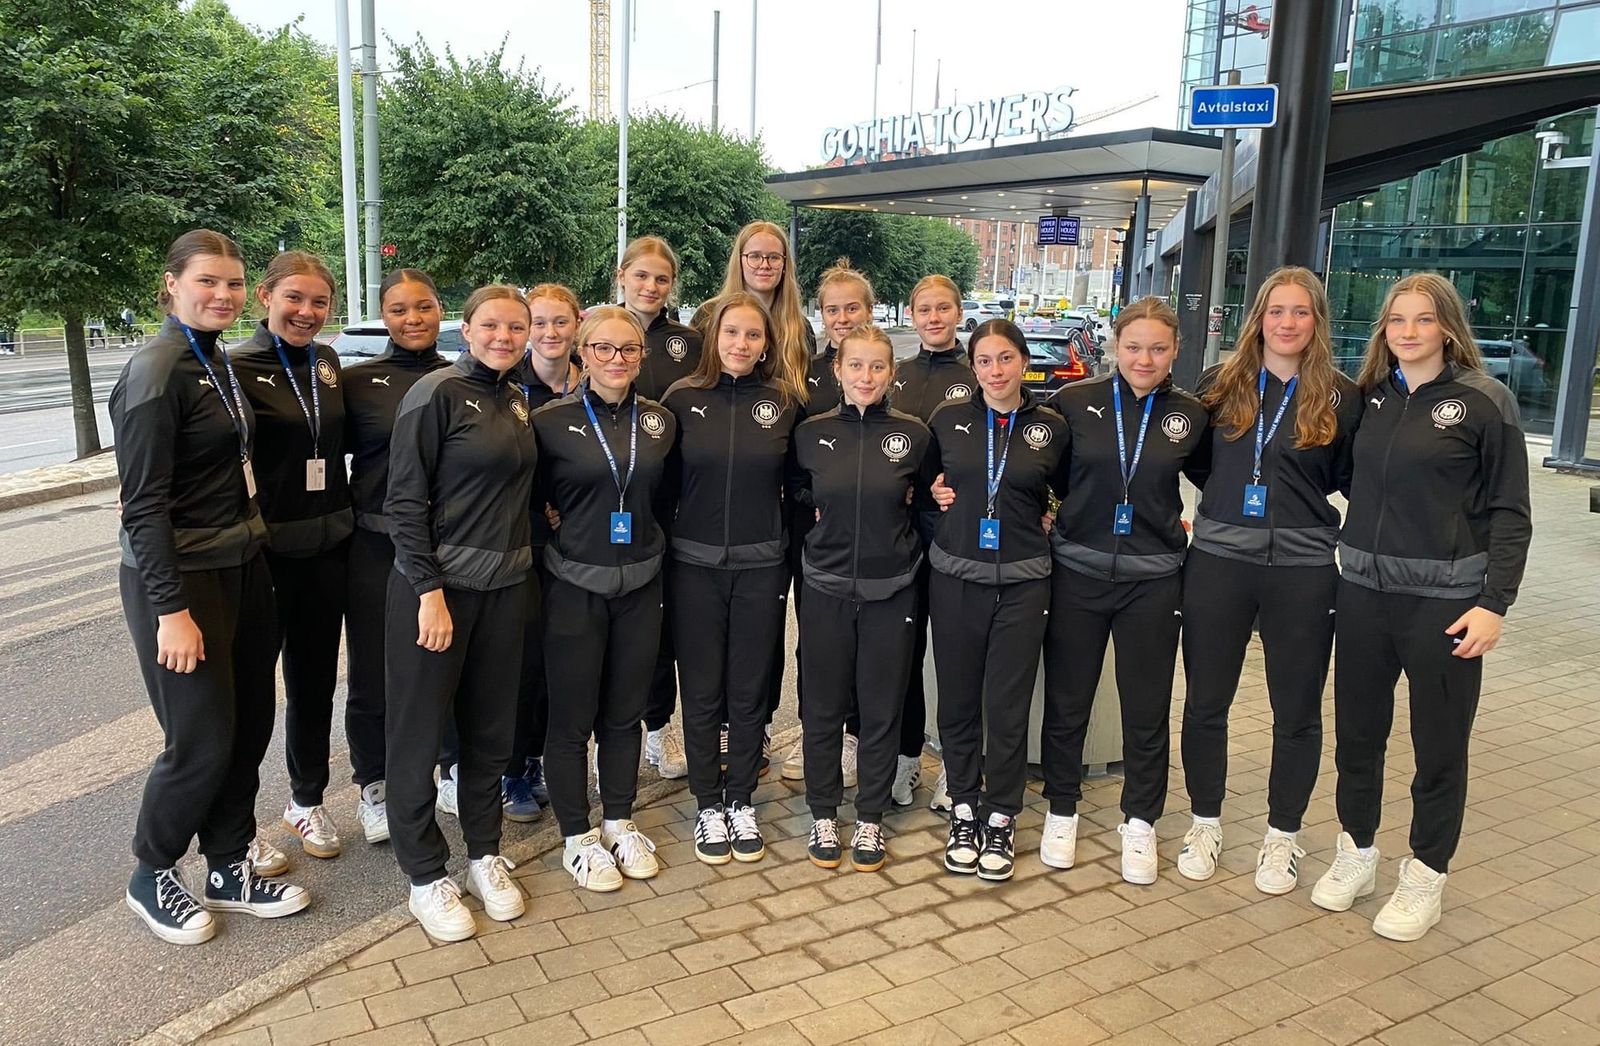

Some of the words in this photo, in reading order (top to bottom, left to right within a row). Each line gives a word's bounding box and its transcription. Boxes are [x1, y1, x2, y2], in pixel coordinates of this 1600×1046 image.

[1197, 100, 1269, 113] Avtalstaxi
[821, 110, 928, 162] GOTHIA
[931, 85, 1074, 147] TOWERS
[204, 362, 213, 375] CUP
[284, 366, 293, 378] CUP
[211, 374, 223, 395] WORLD
[289, 377, 301, 396] WORLD
[232, 387, 242, 407] WORLD
[1273, 405, 1285, 424] WORLD
[1281, 395, 1290, 406] CUP
[592, 421, 605, 442] PARTILLE
[601, 441, 612, 460] WORLD
[608, 460, 617, 471] CUP
[1132, 442, 1142, 464] PARTILLE
[1137, 423, 1147, 442] WORLD
[995, 459, 1005, 480] PARTILLE
